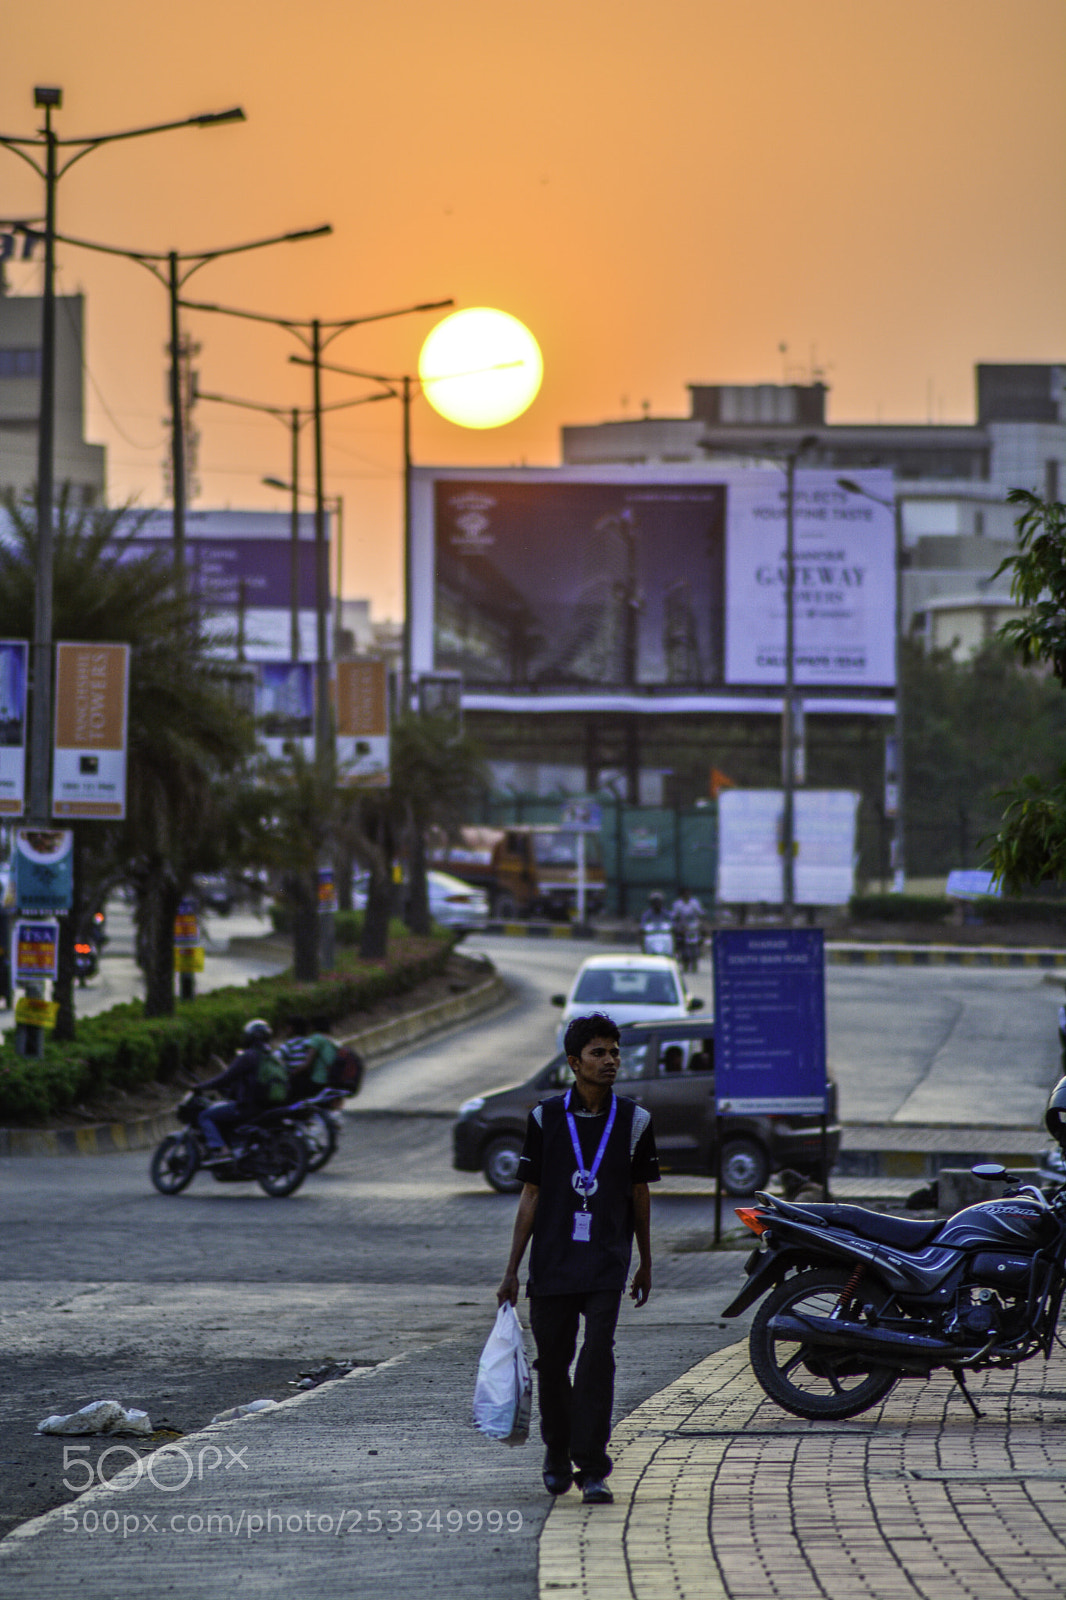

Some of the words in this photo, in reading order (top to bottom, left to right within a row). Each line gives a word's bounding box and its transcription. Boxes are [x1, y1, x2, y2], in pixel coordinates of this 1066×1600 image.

[779, 491, 848, 502] RFLECTS
[75, 653, 91, 742] PANCHSHIL
[89, 651, 109, 742] TOWERS
[784, 954, 808, 963] ROAD
